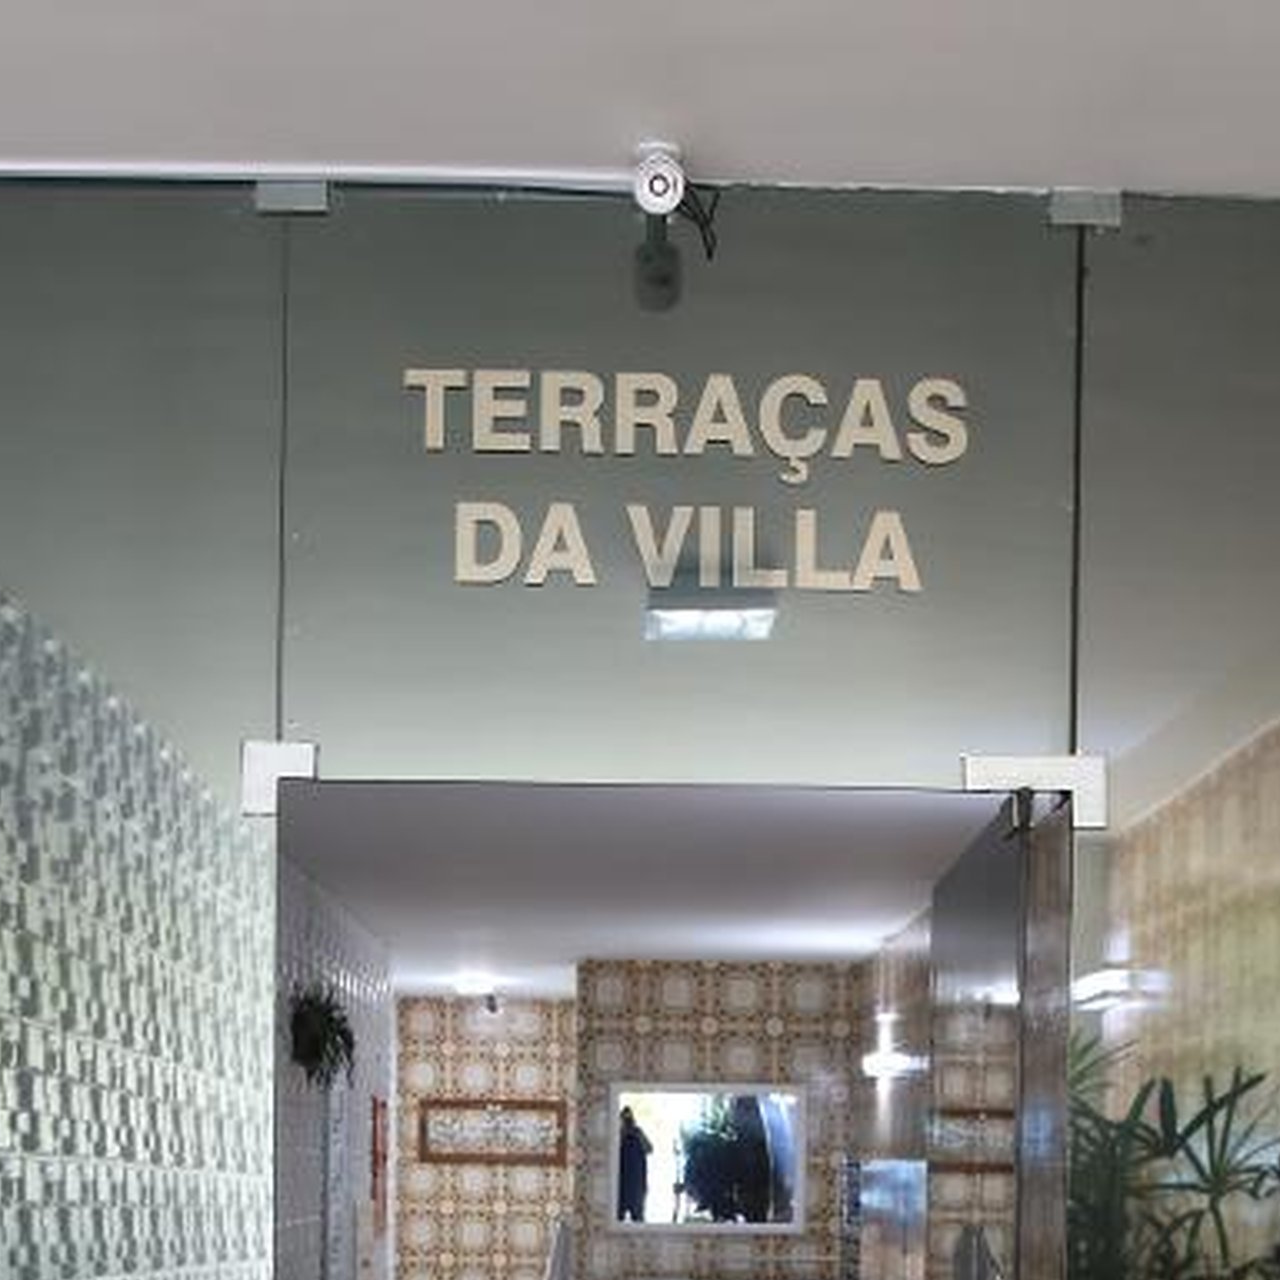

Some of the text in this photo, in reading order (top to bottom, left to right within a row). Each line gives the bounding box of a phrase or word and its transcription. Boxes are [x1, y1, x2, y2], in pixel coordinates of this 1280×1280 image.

[404, 368, 970, 483] TERRAÇAS
[453, 502, 923, 592] DA VILLA
